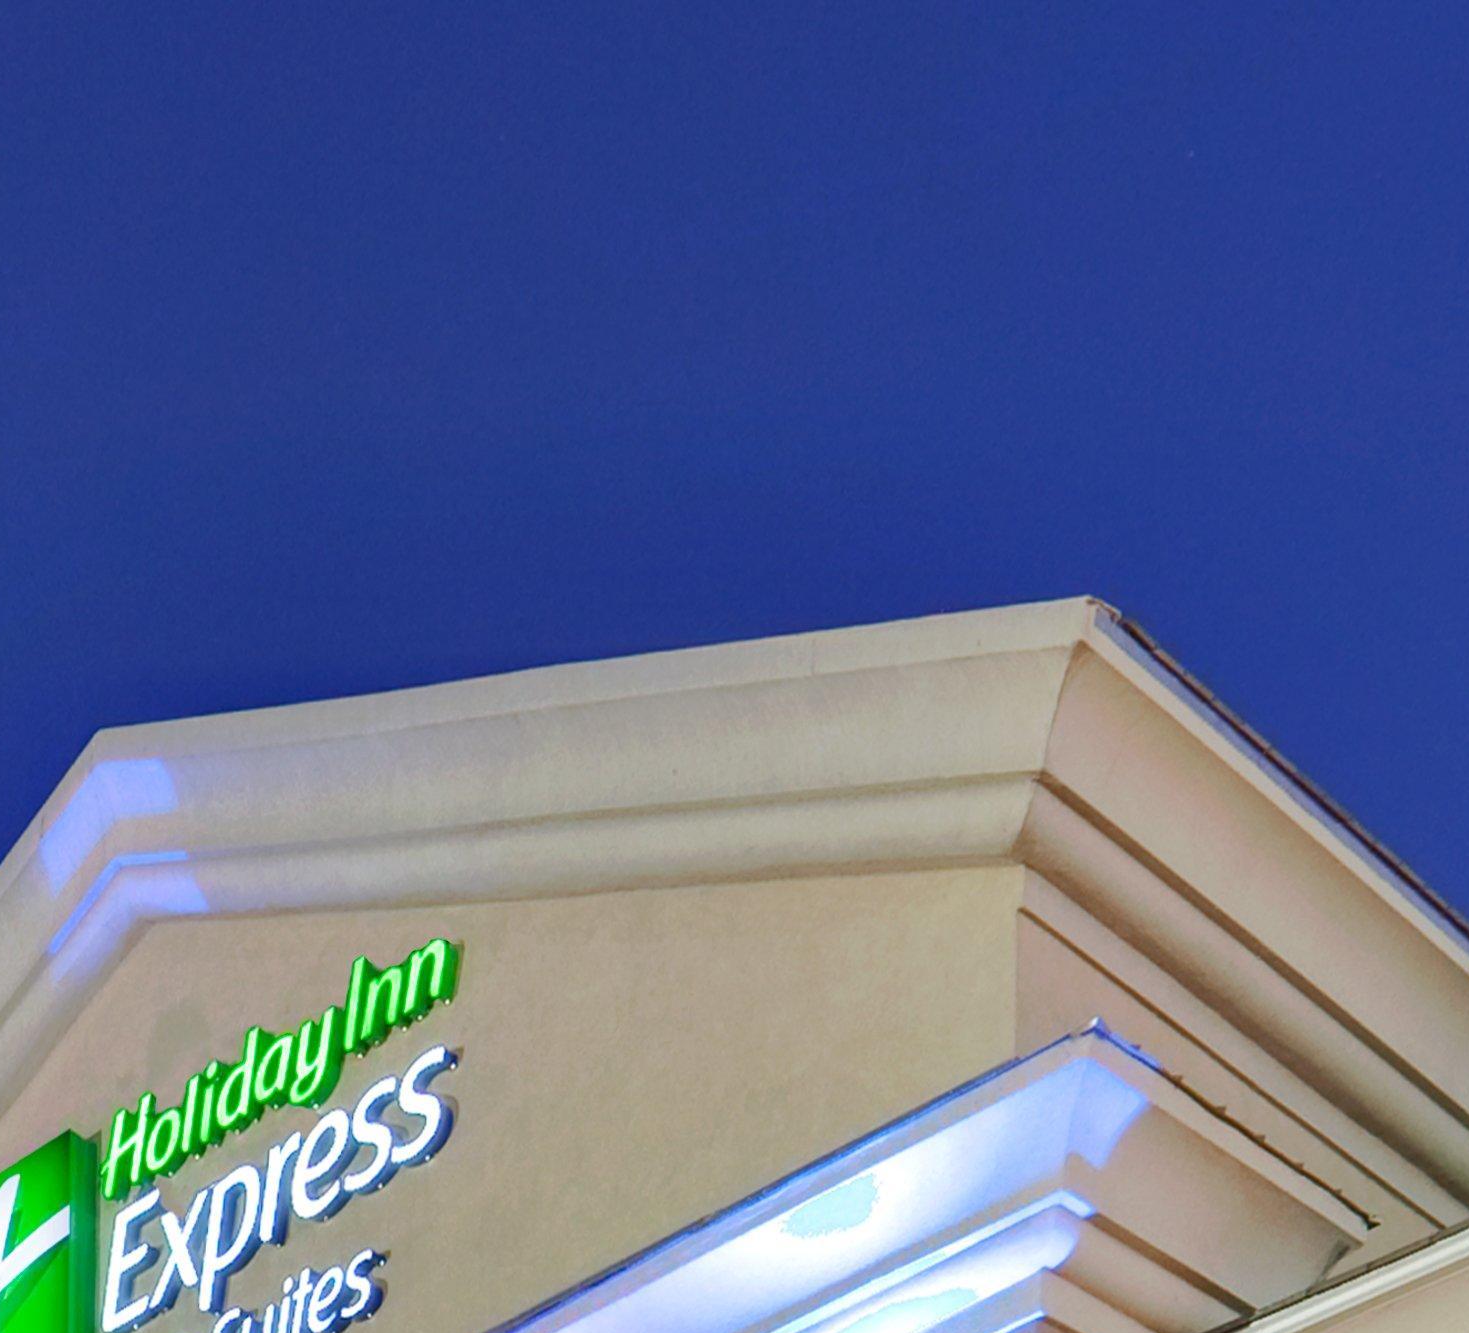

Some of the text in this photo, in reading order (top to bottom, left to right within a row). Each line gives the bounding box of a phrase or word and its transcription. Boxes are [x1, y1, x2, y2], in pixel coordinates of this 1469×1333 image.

[100, 937, 455, 1200] Holiday Inn
[101, 1044, 450, 1333] Express
